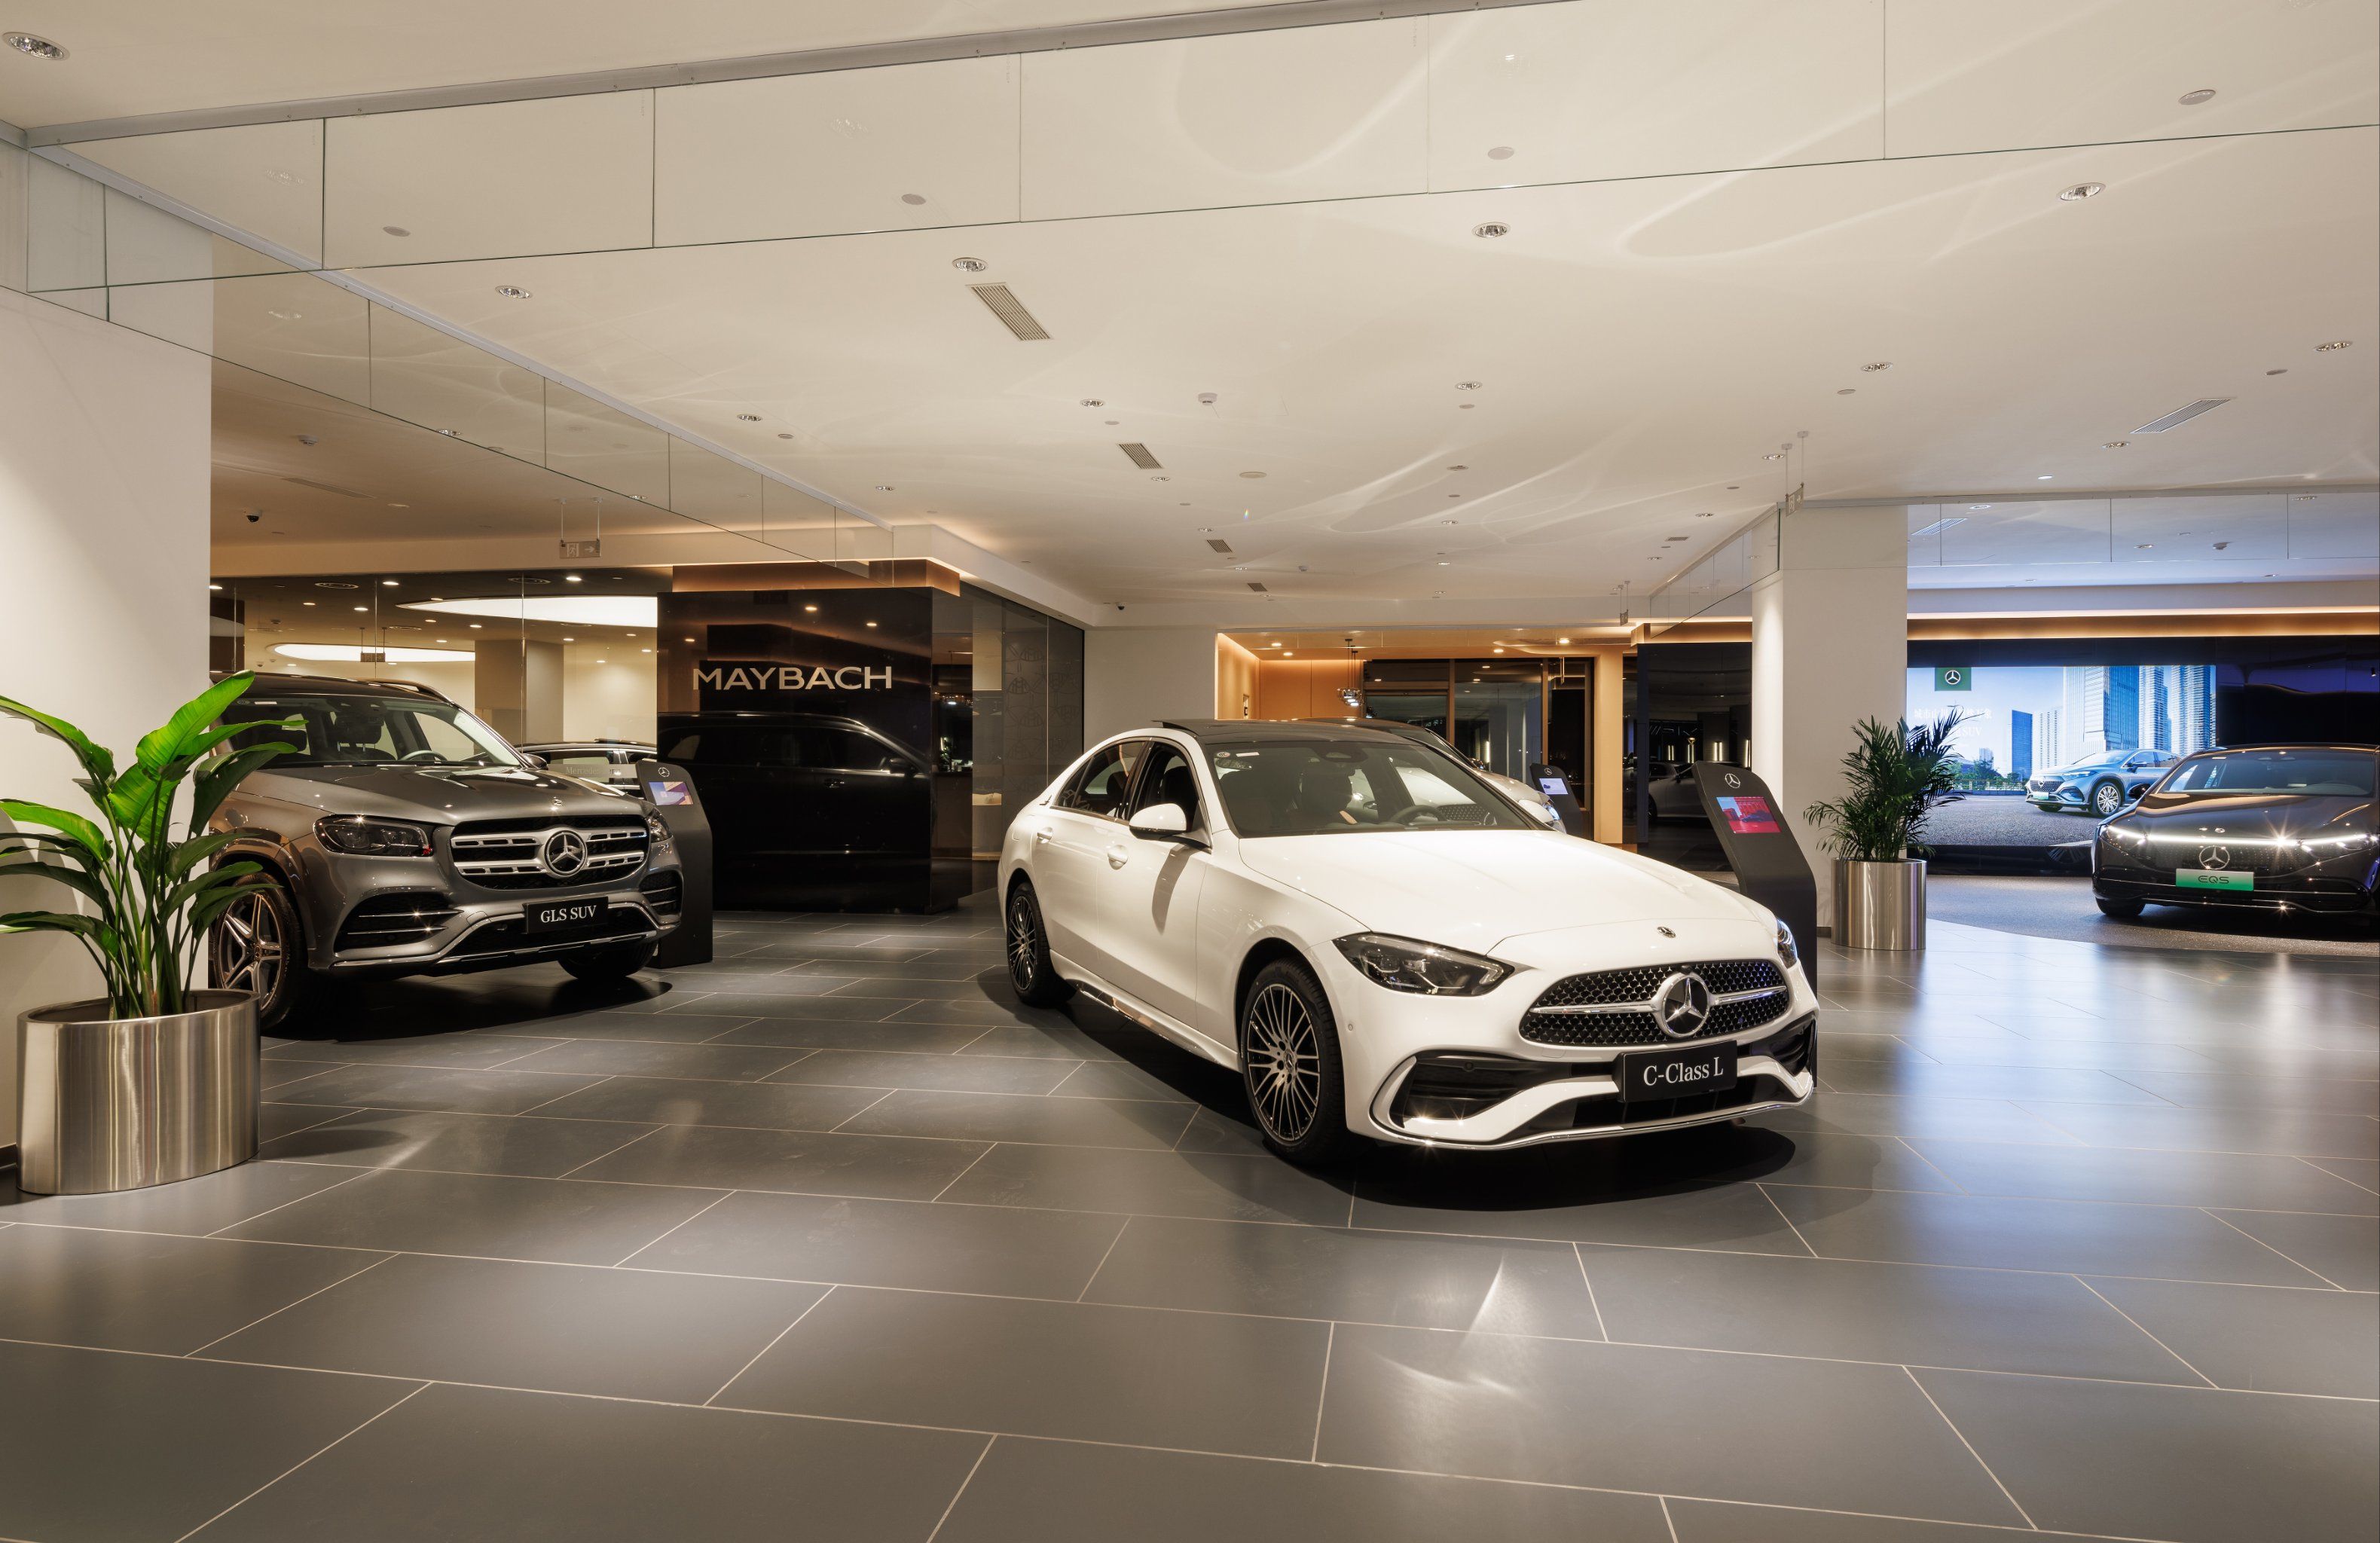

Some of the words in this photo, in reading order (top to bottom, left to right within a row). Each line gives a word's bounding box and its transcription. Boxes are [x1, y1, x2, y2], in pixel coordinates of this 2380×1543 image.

[692, 666, 892, 690] MAYBACH
[2198, 875, 2230, 885] EQS
[540, 908, 567, 923] GLS
[570, 905, 597, 920] SUV
[1643, 1062, 1709, 1086] C-Class
[1713, 1056, 1724, 1077] L
